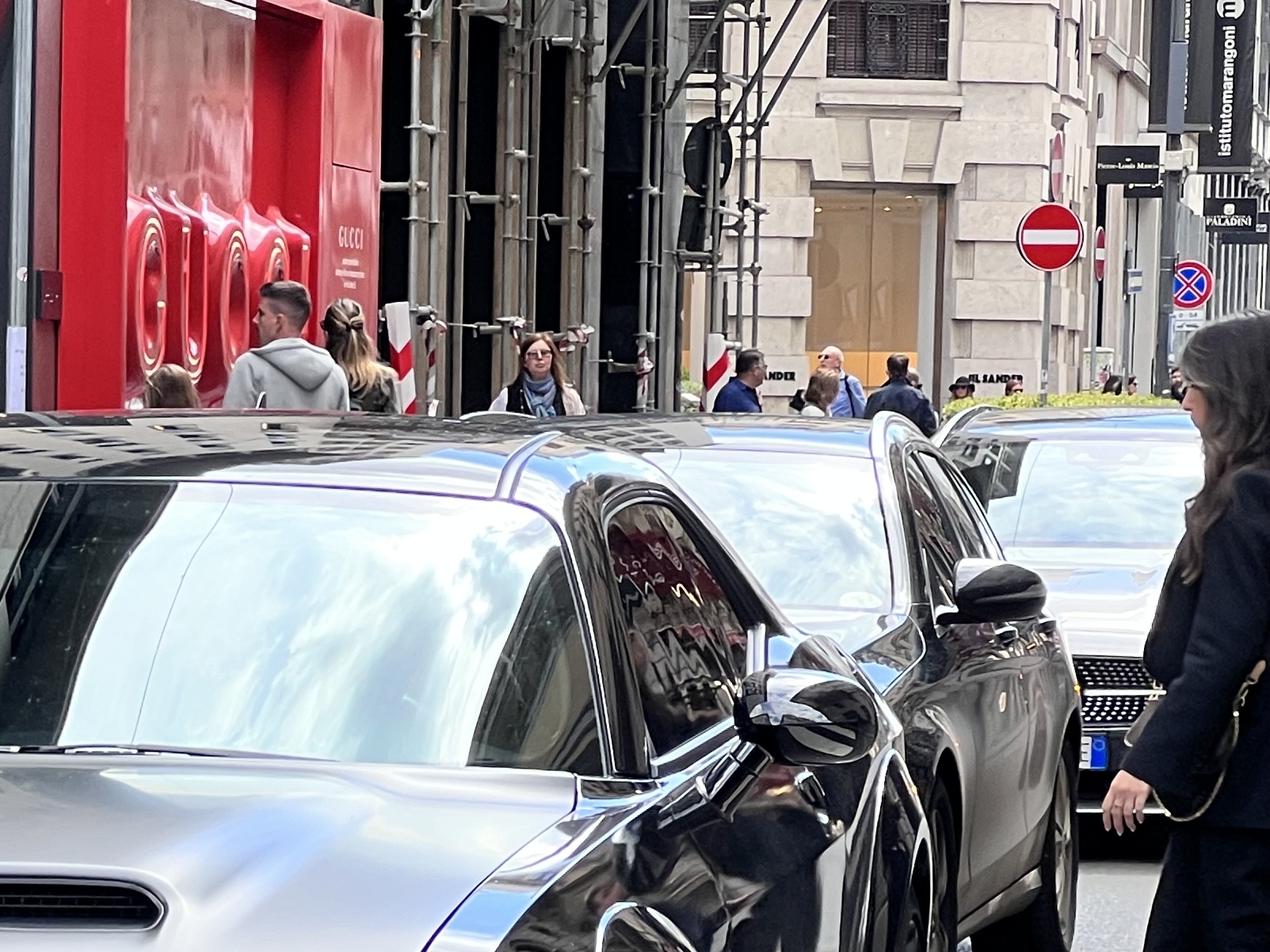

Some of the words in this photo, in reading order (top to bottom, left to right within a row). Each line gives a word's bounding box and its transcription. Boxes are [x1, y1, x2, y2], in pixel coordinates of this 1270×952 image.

[1217, 26, 1238, 157] istitutomarangoni
[1206, 216, 1253, 227] PALADINI
[338, 225, 364, 250] GUCCI
